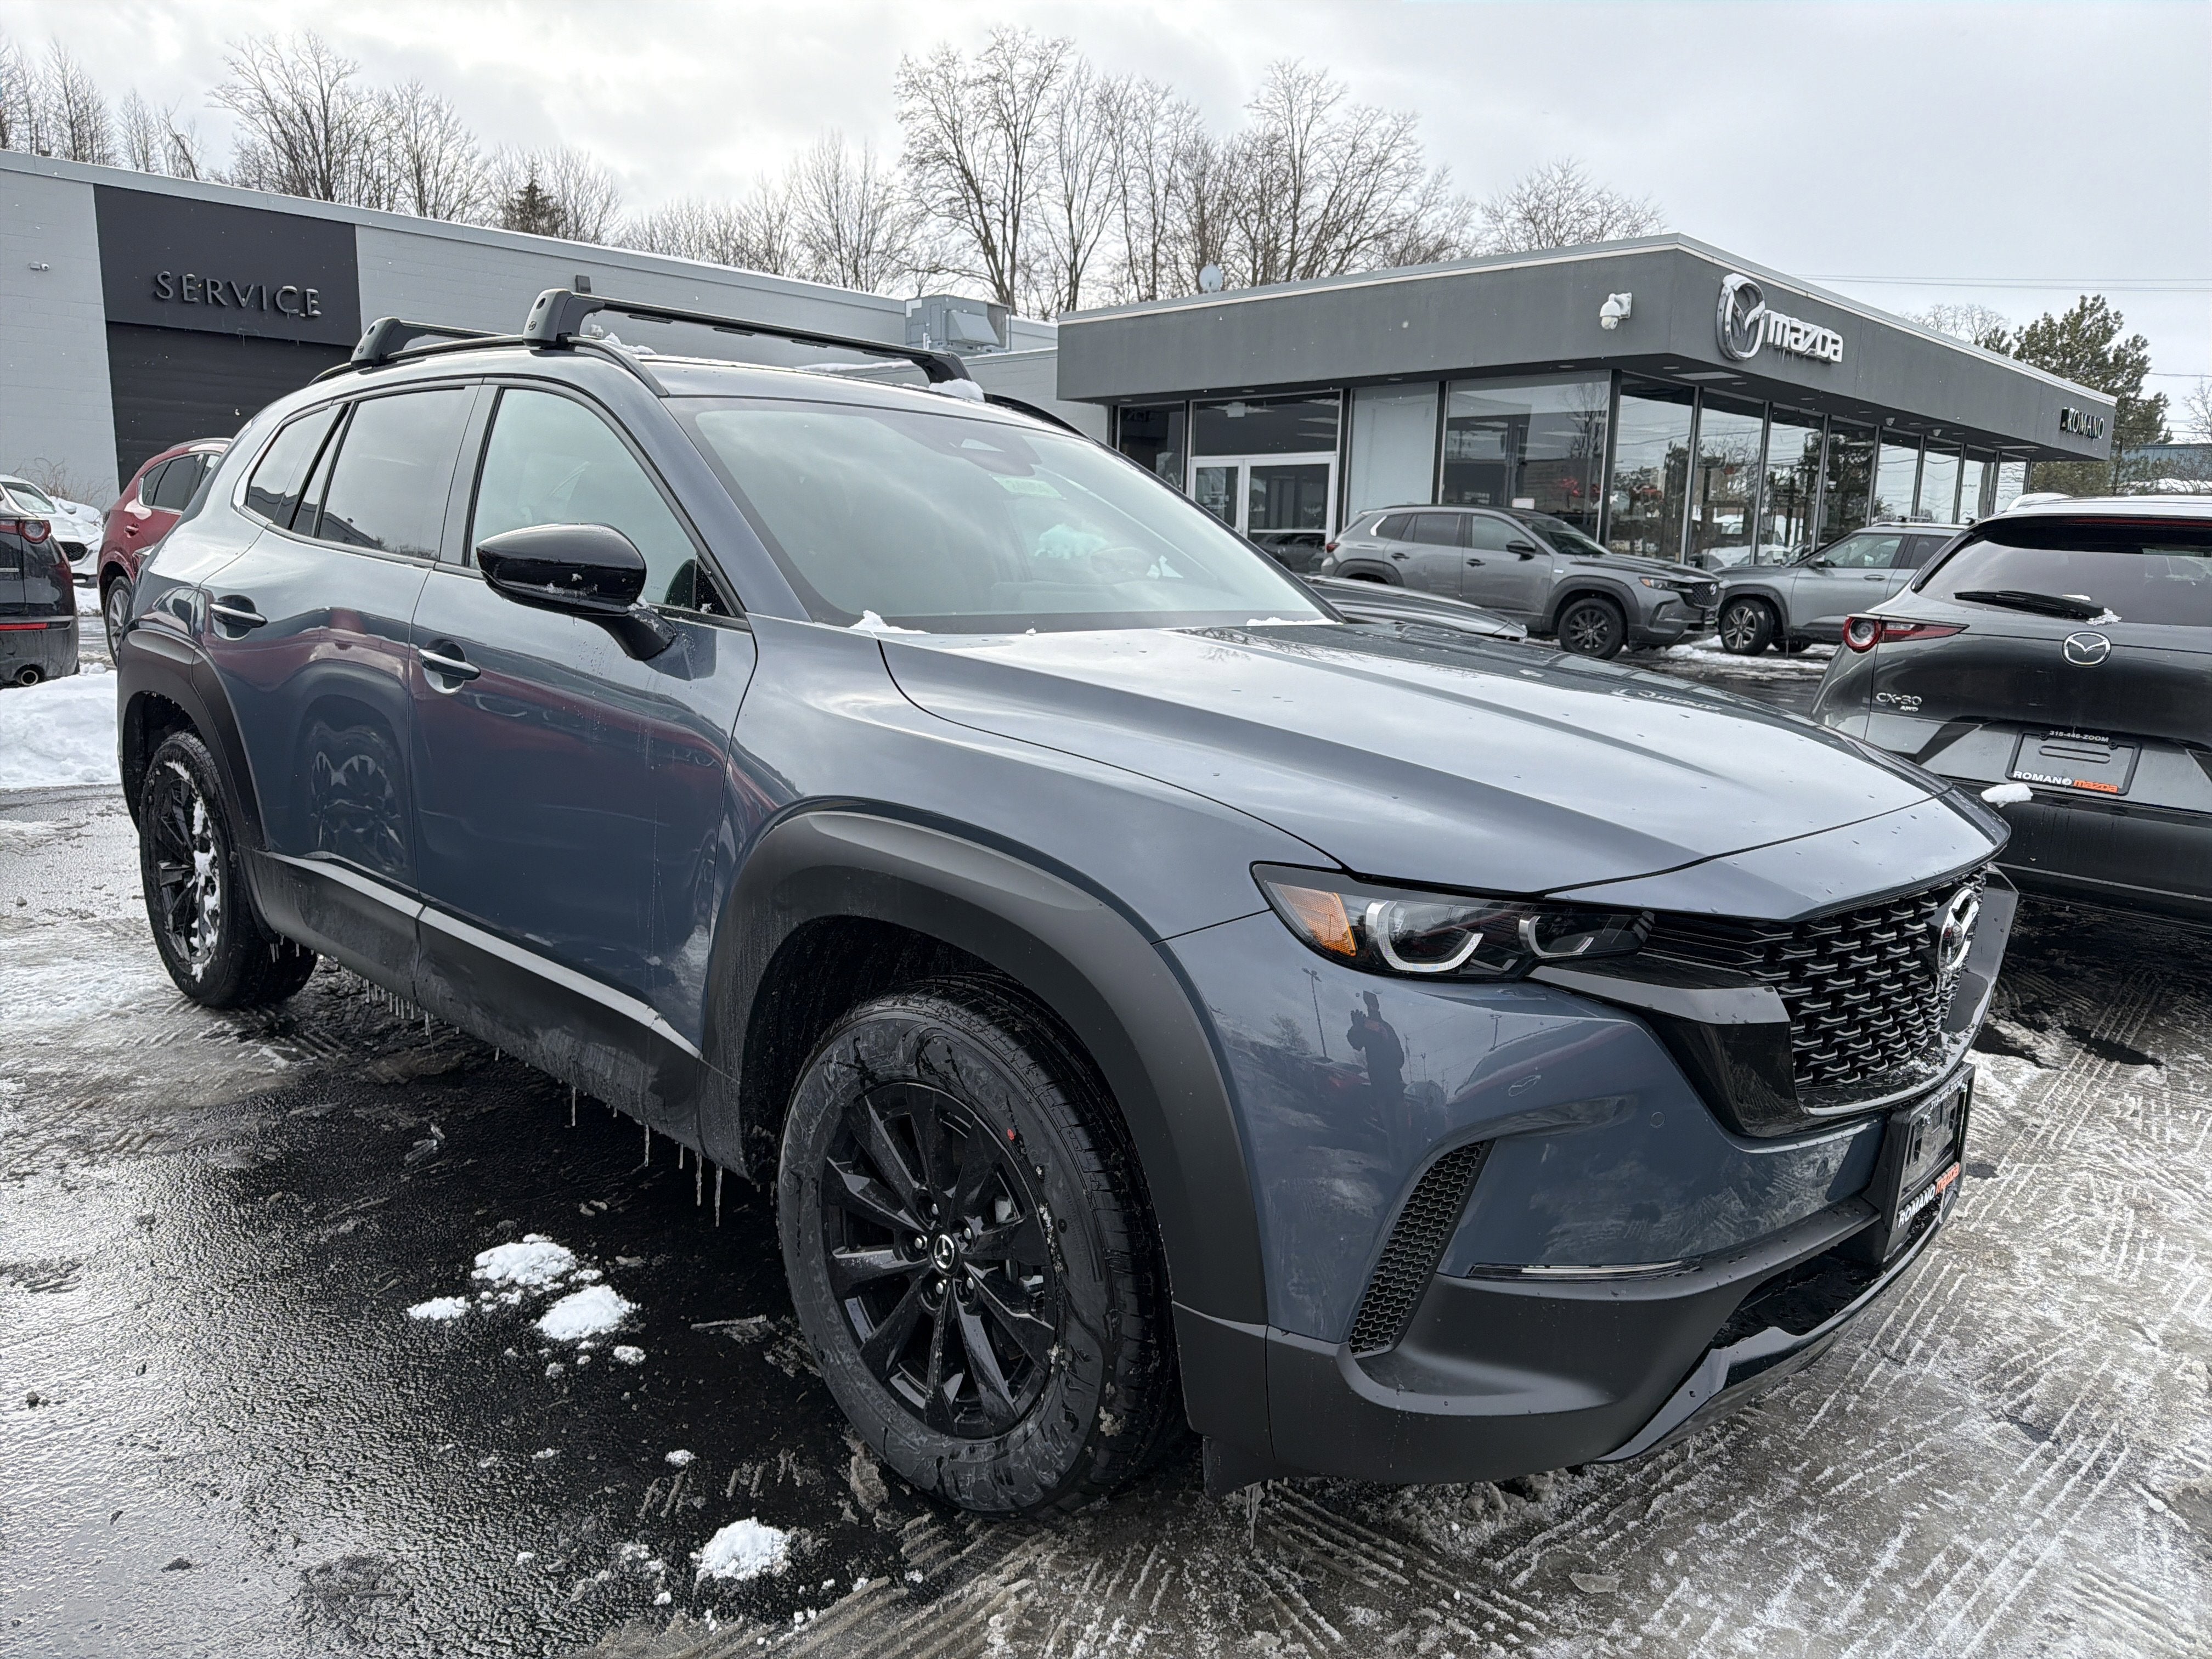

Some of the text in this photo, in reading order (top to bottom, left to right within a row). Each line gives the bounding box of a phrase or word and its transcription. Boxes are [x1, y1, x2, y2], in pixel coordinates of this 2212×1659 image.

[155, 271, 322, 317] SERVICE
[1764, 309, 1843, 363] mazda
[2067, 407, 2104, 439] ROMANO
[1876, 692, 1922, 706] CX-30
[2049, 730, 2109, 742] 315-446-ZOOM
[2013, 770, 2119, 793] ROMANO mazda
[1898, 1183, 1936, 1229] ROMANO
